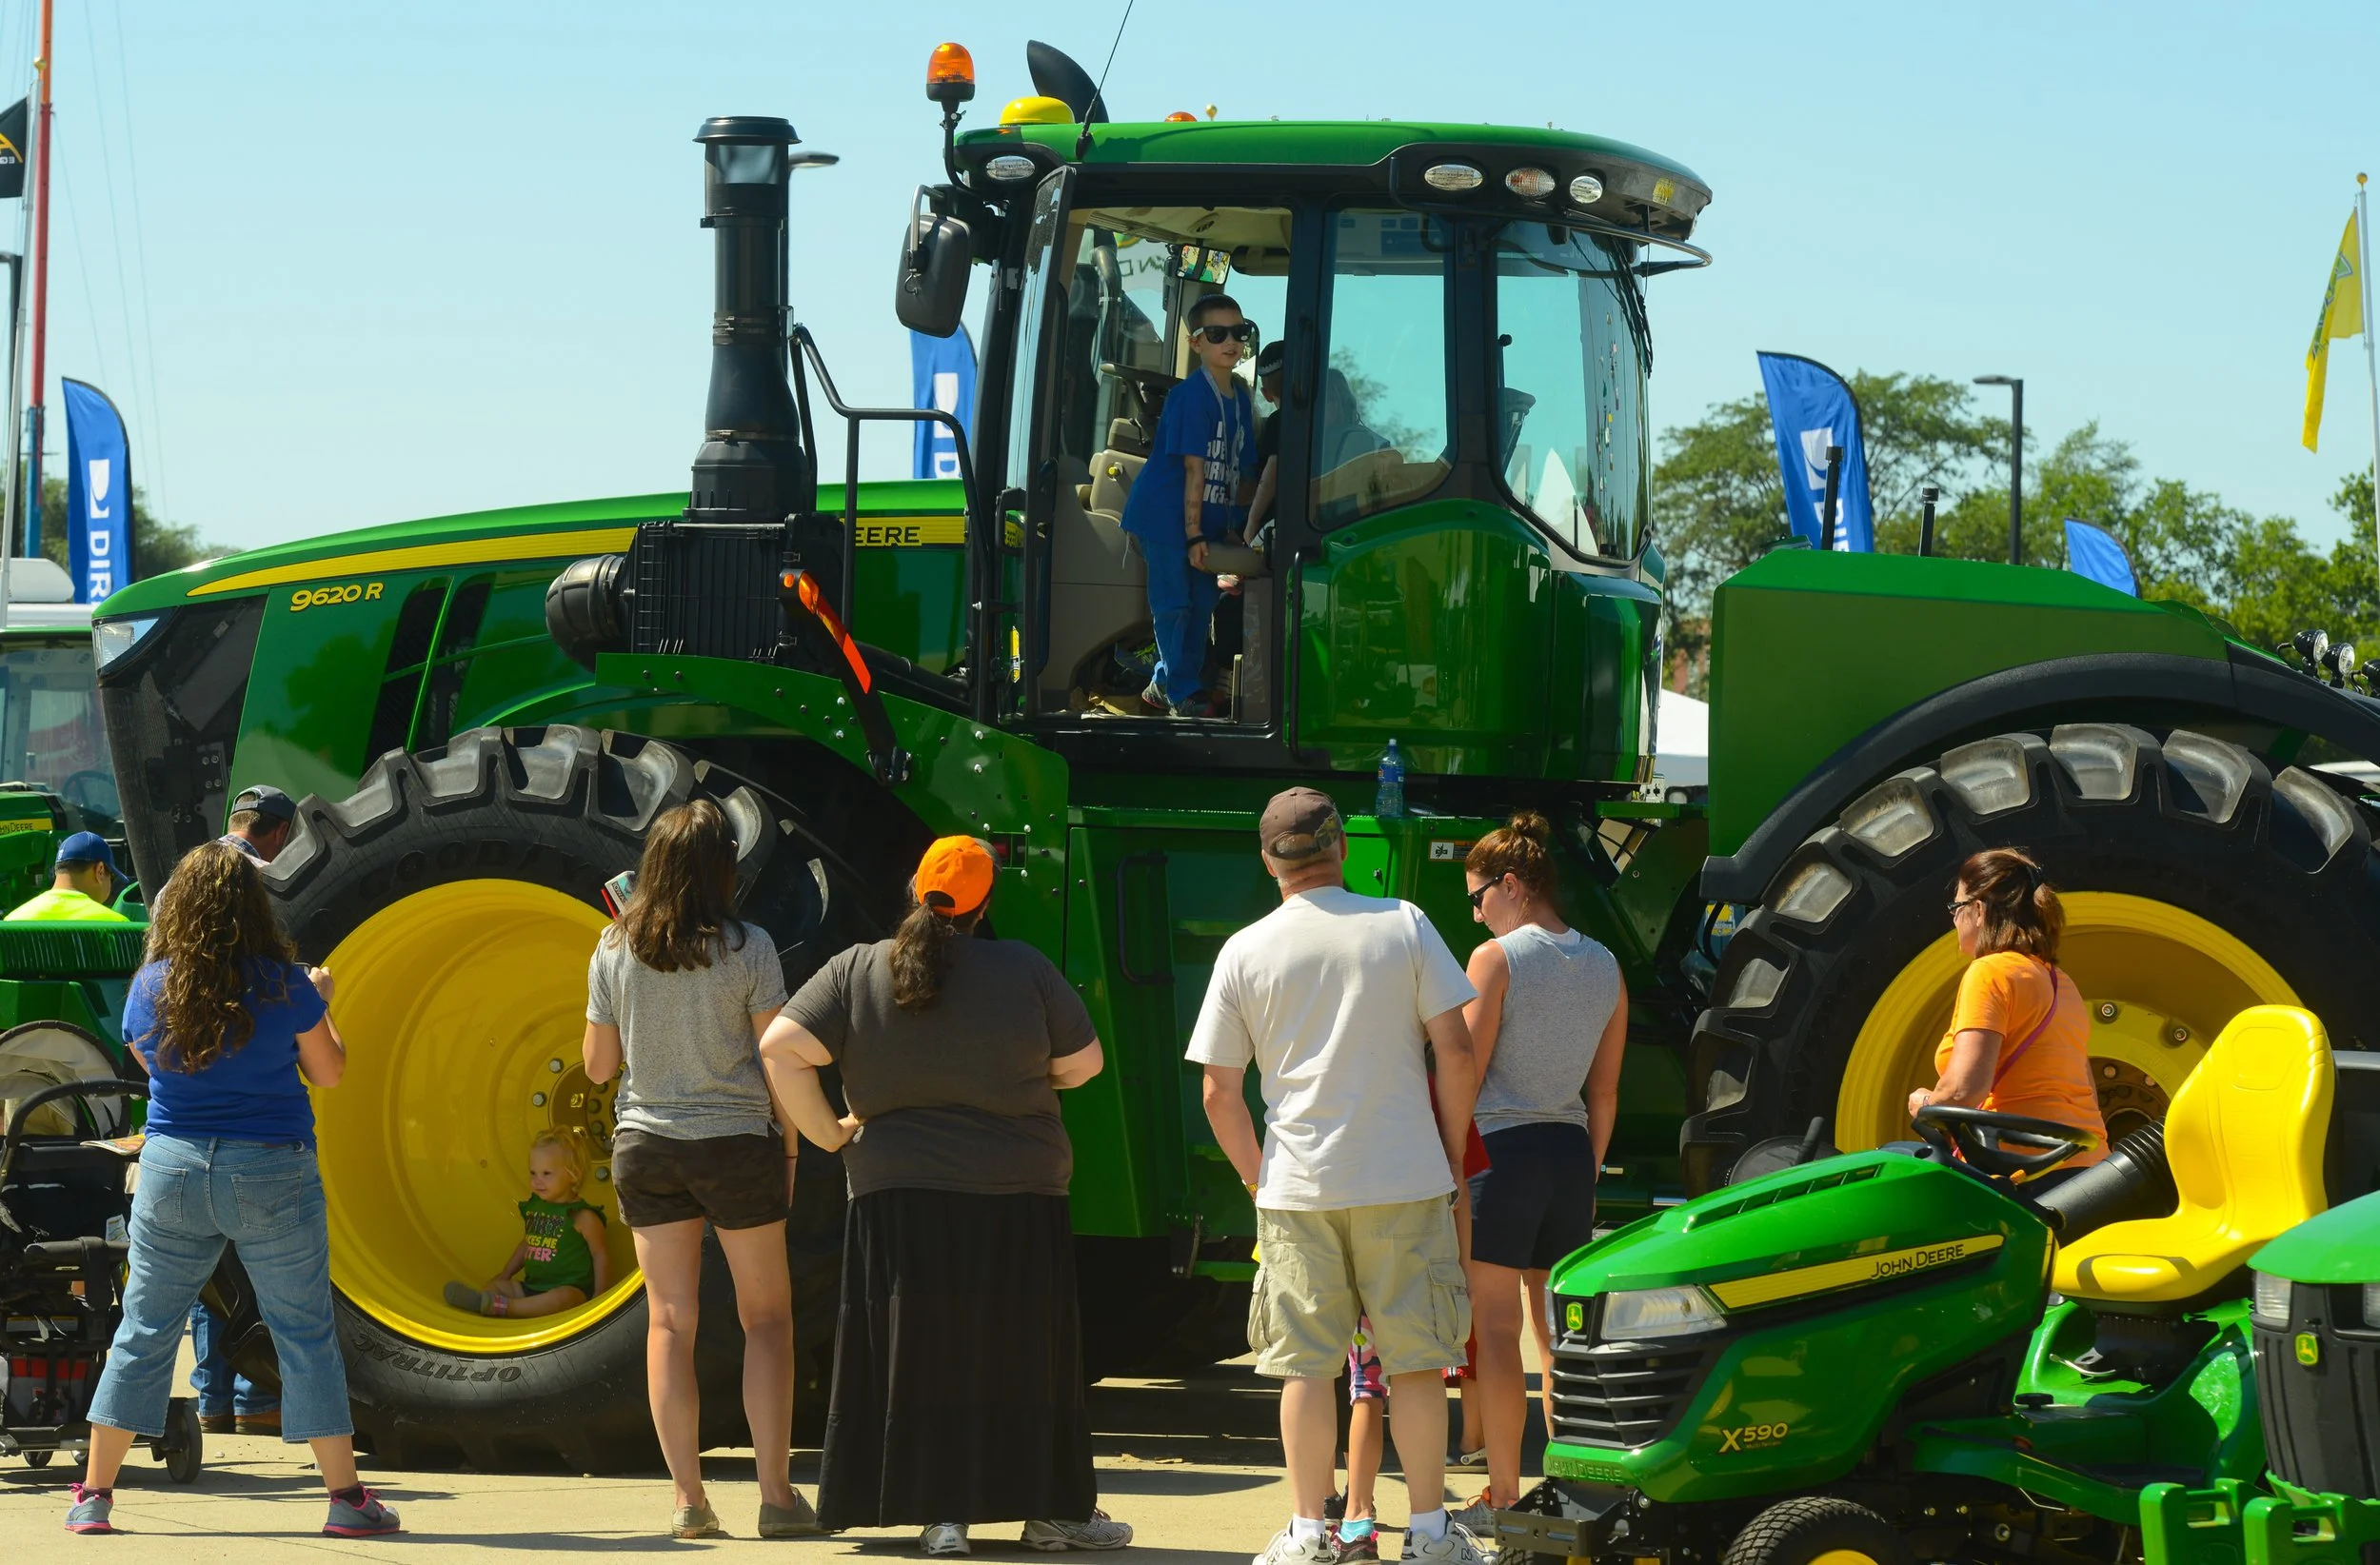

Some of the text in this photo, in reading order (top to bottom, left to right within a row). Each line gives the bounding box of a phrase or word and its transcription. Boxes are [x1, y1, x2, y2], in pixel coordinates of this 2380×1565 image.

[855, 525, 921, 544] EERE
[89, 529, 112, 605] DIR
[1872, 1243, 1964, 1278] JOHN DEERE
[1718, 1422, 1788, 1453] X590
